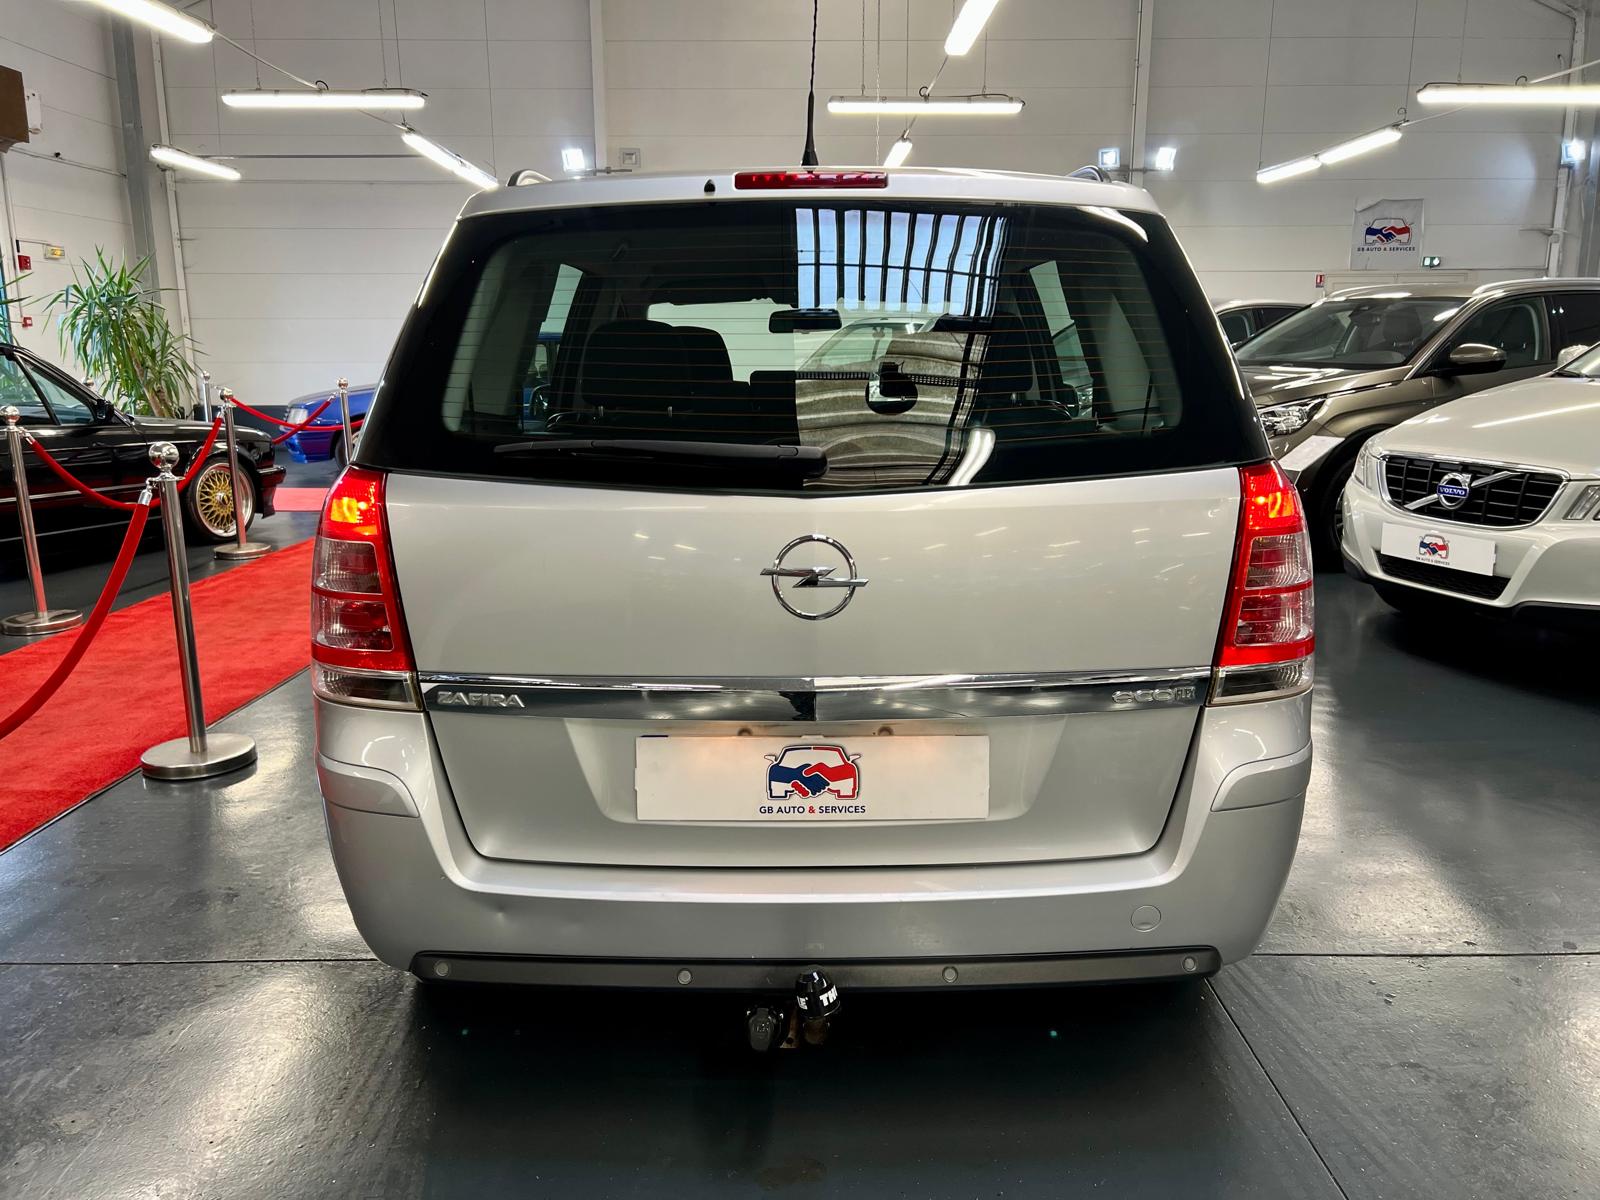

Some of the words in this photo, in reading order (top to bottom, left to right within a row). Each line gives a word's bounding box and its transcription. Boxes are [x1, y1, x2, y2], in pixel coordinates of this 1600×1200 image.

[1439, 486, 1465, 496] VOLVO
[437, 691, 525, 708] ZAFIRA
[759, 806, 774, 814] GB
[776, 806, 806, 814] AUTO
[808, 805, 816, 814] &
[818, 805, 866, 814] SERVICES
